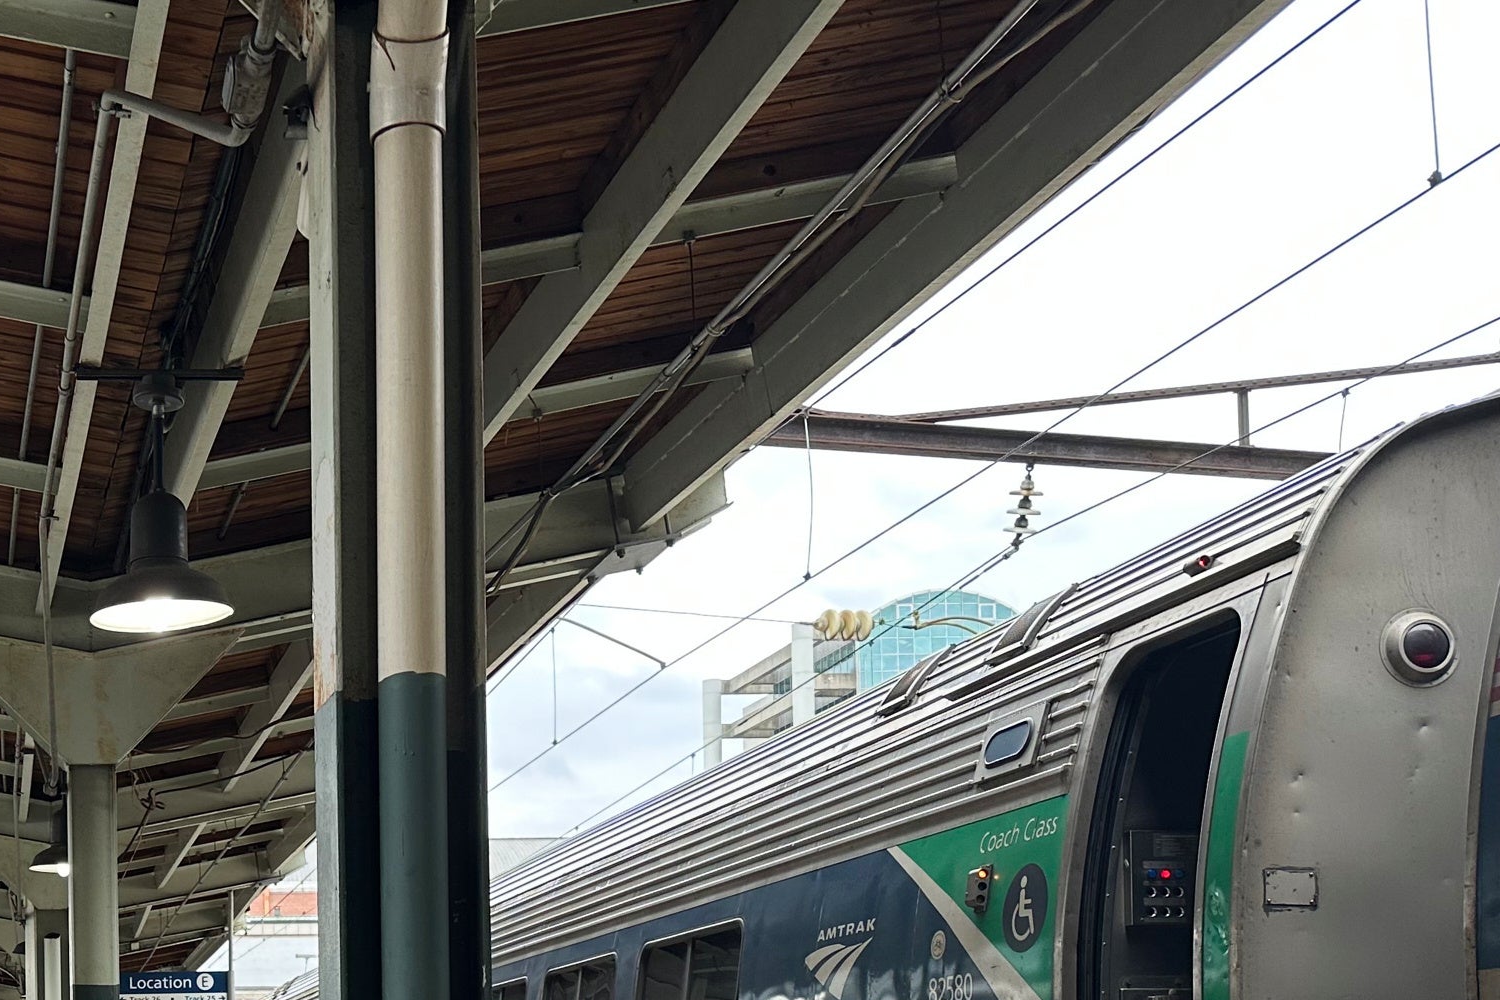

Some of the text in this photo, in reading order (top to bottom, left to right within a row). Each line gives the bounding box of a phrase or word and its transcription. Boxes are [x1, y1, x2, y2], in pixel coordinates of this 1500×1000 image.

[979, 816, 1058, 854] Coach Class
[817, 918, 877, 943] AMTRAK
[128, 976, 192, 989] Location
